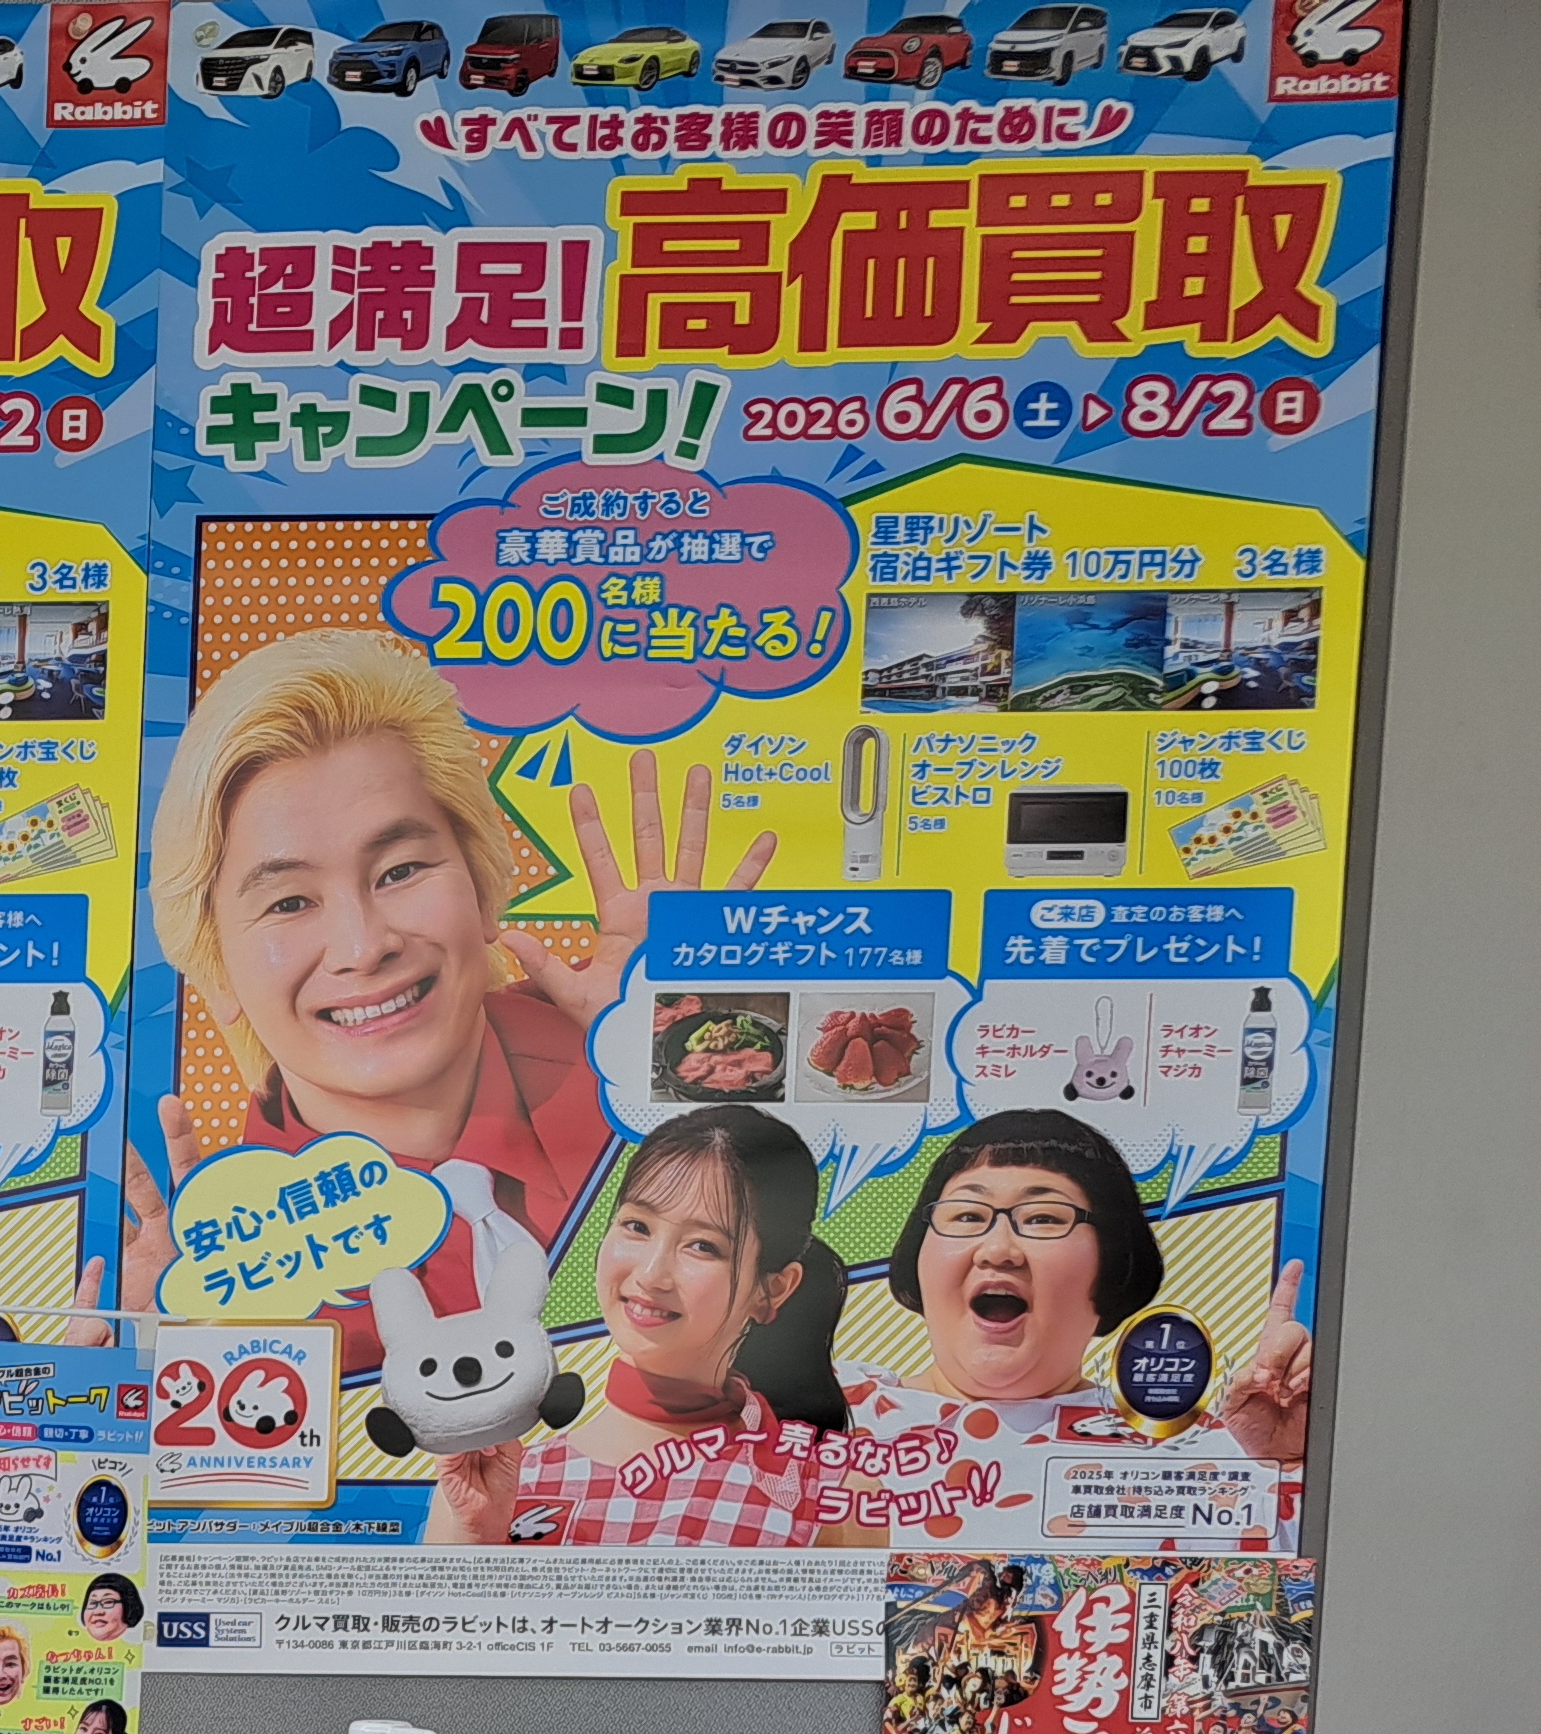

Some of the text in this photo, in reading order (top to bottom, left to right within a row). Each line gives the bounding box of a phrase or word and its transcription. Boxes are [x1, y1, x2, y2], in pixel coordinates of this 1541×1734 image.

[1274, 73, 1390, 94] Rabbit
[54, 100, 158, 122] Rabbit
[462, 105, 1086, 156] すべてはお客様の笑顔のために
[618, 173, 1328, 355] 高価買取
[749, 403, 865, 436] 2026
[540, 491, 709, 519] ご成約すると
[871, 516, 1049, 547] 星野リゾート
[497, 531, 772, 566] 豪華賞品が抽選で
[1238, 548, 1322, 577] 3名様
[432, 577, 661, 664] 200 名様
[723, 734, 807, 756] ダイソン
[912, 732, 1037, 755] パナソニック
[1155, 730, 1306, 753] ジャンボ宝くじ
[723, 761, 832, 783] Hot+Cool
[911, 759, 1062, 780] オーブンレンジ
[1156, 758, 1221, 780] 100枚
[911, 785, 992, 806] ビストロ
[1039, 903, 1244, 924] ご来店 査定のお客様へ
[672, 942, 923, 969] カタログギフト 177名様
[977, 1024, 1035, 1039] ラビカー
[1159, 1024, 1217, 1039] ライオン
[976, 1043, 1068, 1059] キーホルダー
[1159, 1044, 1233, 1059] チャーミー
[976, 1064, 1017, 1078] スミレ
[1158, 1064, 1202, 1079] マジカ
[204, 1214, 394, 1306] ラビットです
[222, 1340, 306, 1365] RABICAR
[1132, 1357, 1196, 1372] オリコン
[97, 1459, 126, 1470] ピコン
[186, 1455, 313, 1469] ANNIVERSARY
[1071, 1471, 1114, 1480] 2025年
[1071, 1486, 1127, 1496] 車買取会社
[85, 1507, 119, 1516] オリコン
[1070, 1504, 1253, 1526] 店舗買取満足度 No.1
[36, 1550, 61, 1562] No.1
[162, 1621, 206, 1639] USS
[570, 1642, 593, 1653] TEL
[1138, 1593, 1161, 1712] 三重県志摩市
